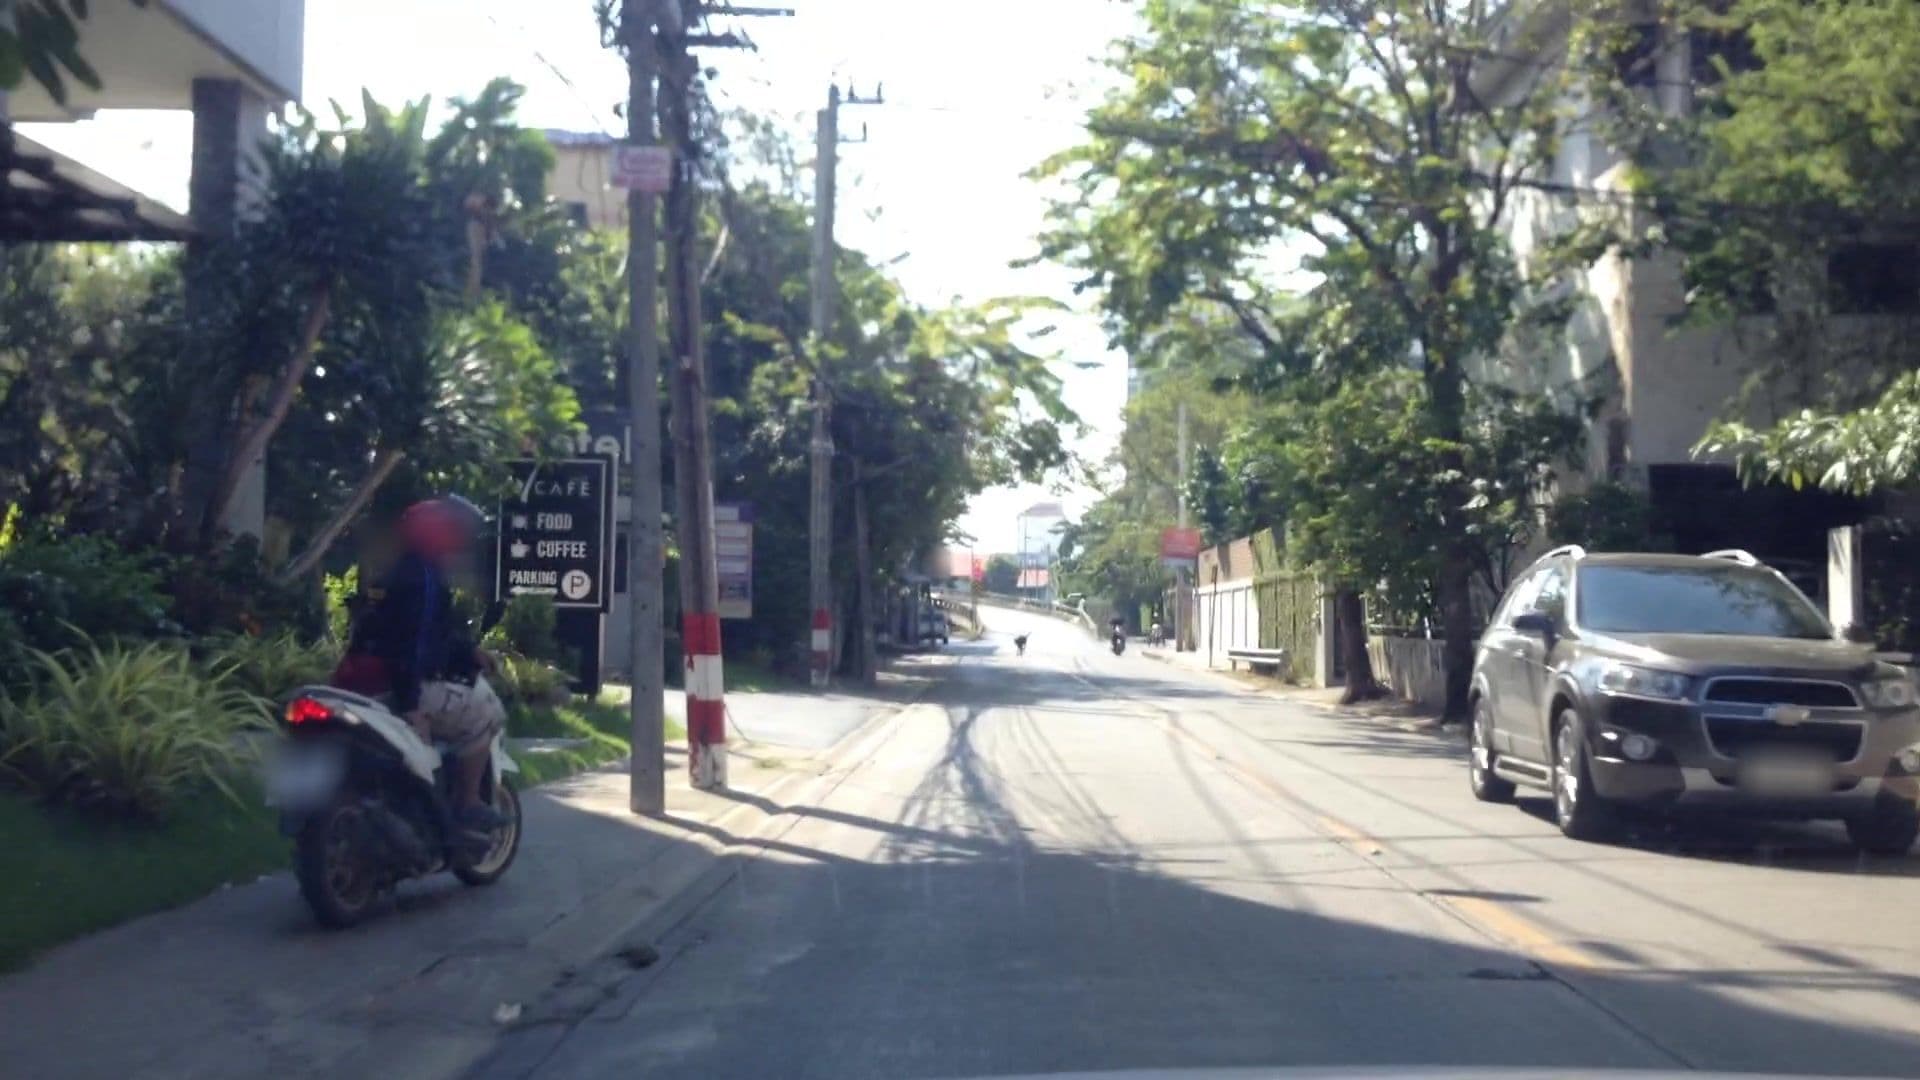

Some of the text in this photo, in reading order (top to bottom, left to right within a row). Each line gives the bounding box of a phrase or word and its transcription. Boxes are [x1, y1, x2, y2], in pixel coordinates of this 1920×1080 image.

[536, 512, 573, 530] FOOD
[536, 540, 588, 558] COFFEE
[508, 569, 558, 585] PARKING
